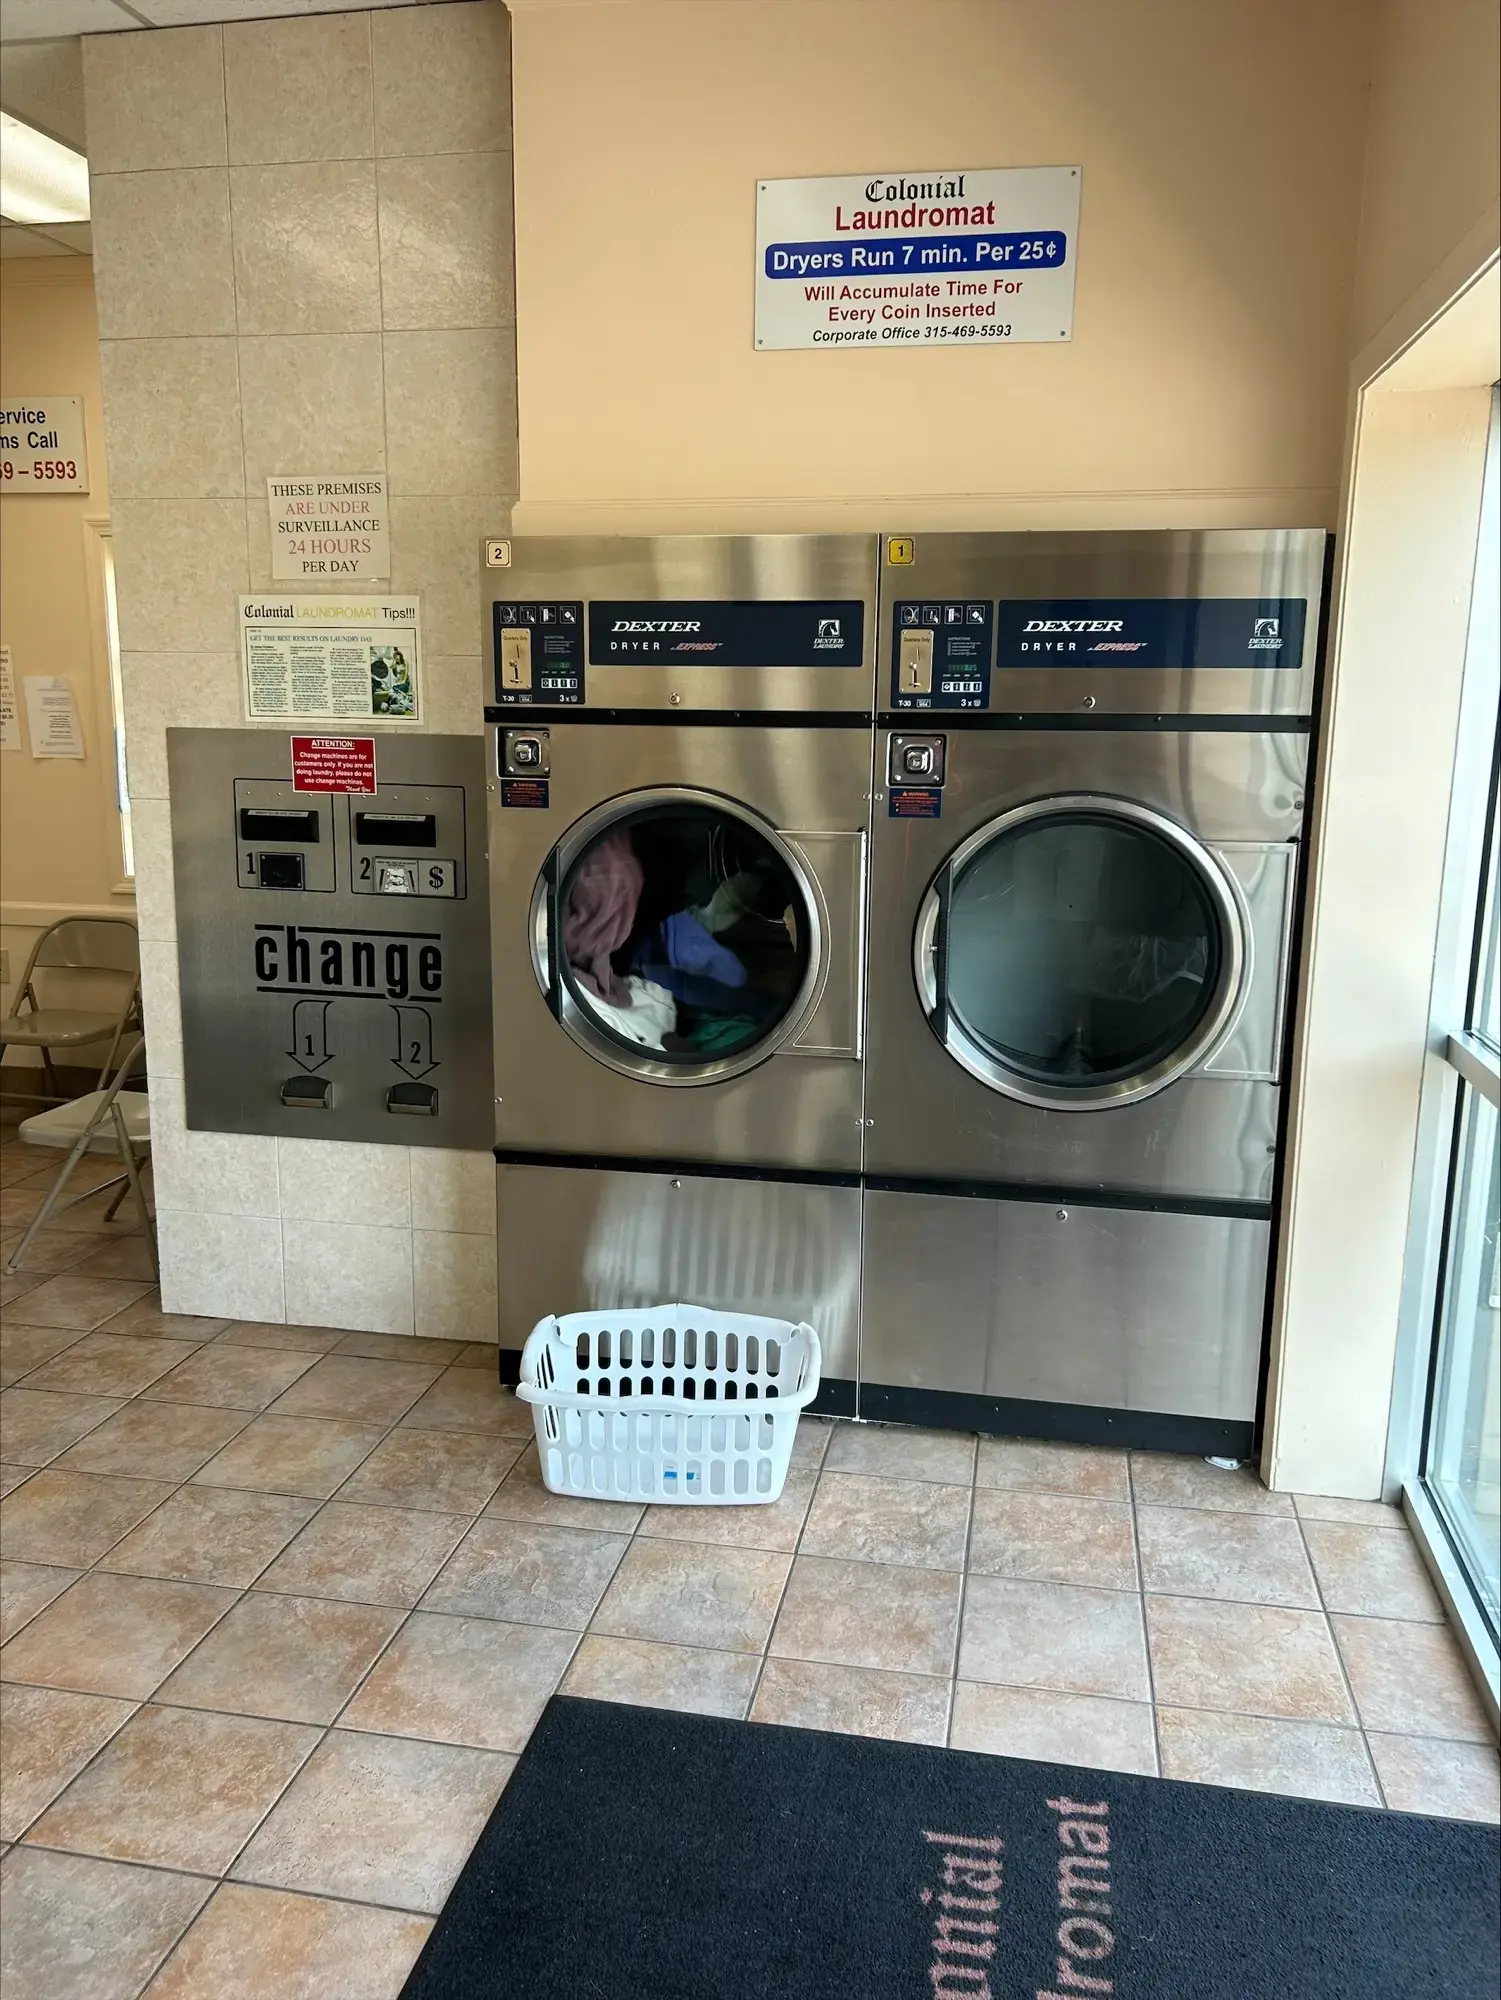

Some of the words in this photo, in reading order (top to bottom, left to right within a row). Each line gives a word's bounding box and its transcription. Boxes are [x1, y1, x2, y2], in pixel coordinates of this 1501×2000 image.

[865, 175, 966, 202] Colonial
[836, 200, 995, 231] Laundromat
[774, 250, 843, 275] Dryers
[851, 246, 894, 267] Run
[902, 245, 914, 265] 7
[921, 244, 967, 265] min.
[976, 241, 1014, 262] Per
[1019, 240, 1057, 261] 25¢
[804, 286, 835, 301] Will
[840, 283, 940, 300] Accumulate
[946, 281, 988, 296] Time
[993, 279, 1023, 294] For
[829, 307, 876, 324] Every
[881, 304, 920, 319] Coin
[926, 301, 996, 318] Inserted
[812, 328, 878, 344] Corporate
[881, 326, 920, 339] Office
[924, 324, 1012, 338] 315-469-5593
[27, 431, 58, 449] Call
[0, 461, 14, 480] 9
[33, 460, 77, 480] 5593
[271, 484, 314, 497] THESE
[317, 482, 382, 495] PREMISES
[286, 502, 316, 515] ARE
[319, 500, 370, 514] UNDER
[278, 519, 381, 533] SURVEILLANCE
[288, 539, 306, 555] 24
[310, 538, 371, 554] HOURS
[494, 547, 502, 559] 2
[897, 545, 904, 557] 1
[302, 561, 327, 573] PER
[330, 560, 359, 572] DAY
[244, 604, 294, 619] Colonial
[295, 606, 379, 619] LAUNDROMAT
[382, 606, 416, 621] Tips!!!
[611, 621, 701, 632] DEXTER
[1022, 620, 1124, 632] DEXTER
[610, 642, 660, 651] DRYER
[1021, 642, 1077, 651] DRYER
[311, 740, 355, 748] ATTENTION:
[300, 751, 320, 760] Change
[296, 768, 312, 776] doing
[315, 777, 335, 785] change
[246, 852, 256, 874] 1
[360, 857, 371, 880] 2
[429, 865, 444, 890] $
[255, 925, 442, 999] change
[304, 1034, 315, 1056] 1
[410, 1041, 421, 1064] 2
[1036, 1796, 1116, 2000] romat
